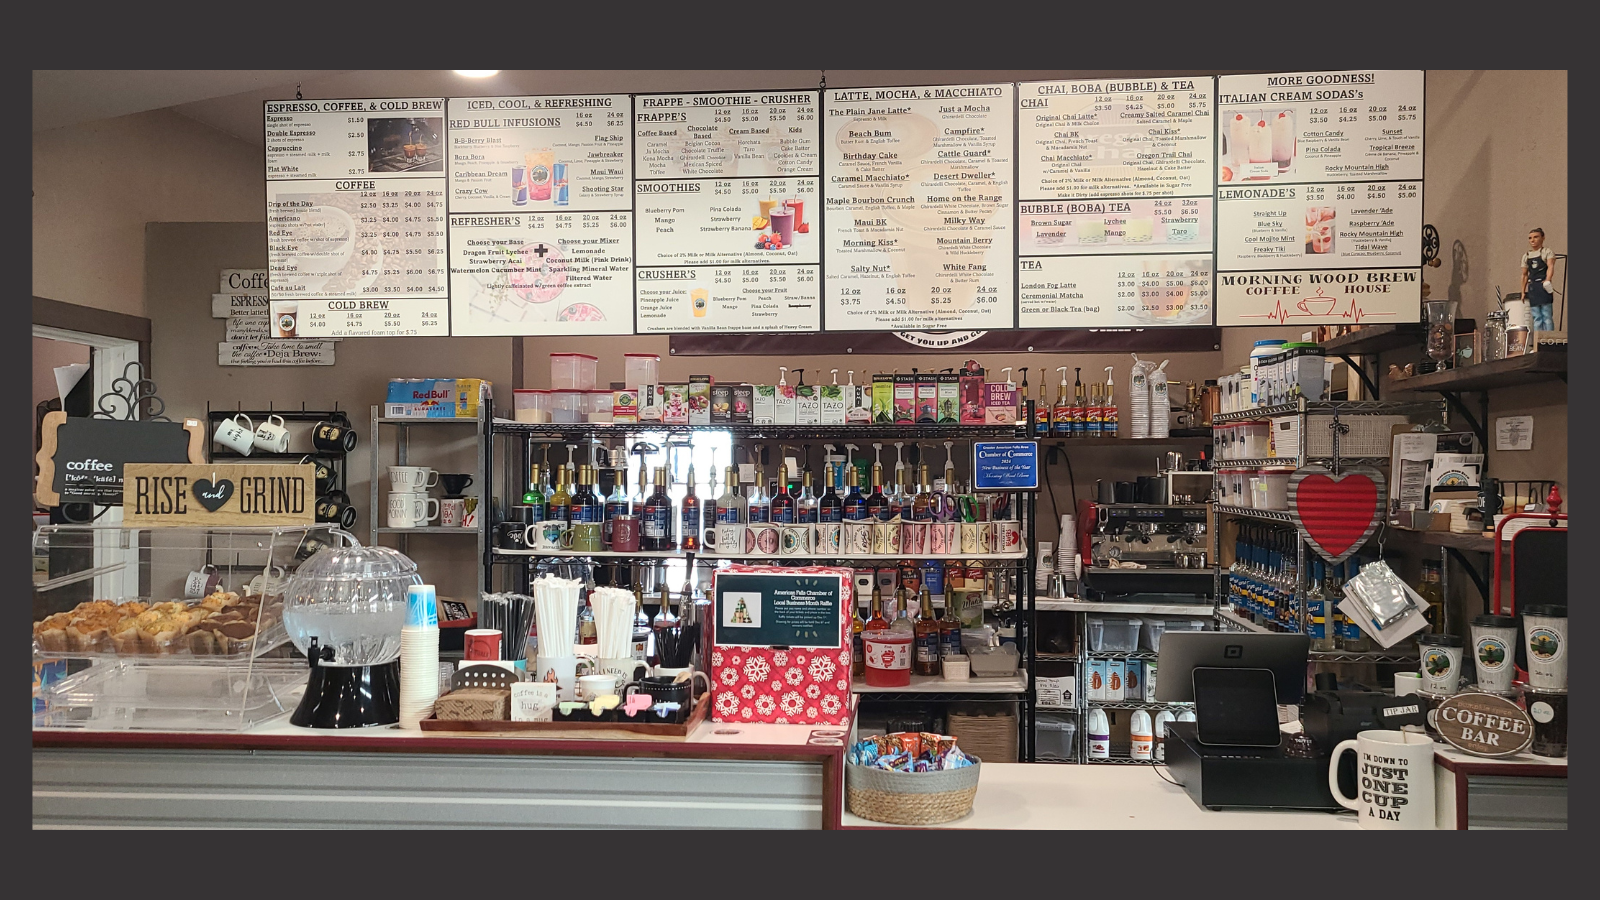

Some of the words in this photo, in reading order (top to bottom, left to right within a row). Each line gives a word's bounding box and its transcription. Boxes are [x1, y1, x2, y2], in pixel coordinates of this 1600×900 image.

[1267, 77, 1302, 86] MORE
[1306, 74, 1374, 84] GOODNESS!
[1038, 86, 1068, 94] CHAI,
[1071, 84, 1102, 93] BOBA
[1105, 82, 1157, 94] (BUBBLE)
[1161, 82, 1169, 90] &
[1172, 81, 1194, 90] TEA
[834, 92, 872, 101] LATTE,
[875, 91, 920, 99] MOCHA,
[934, 88, 1002, 97] MACCHIATO
[1220, 94, 1267, 103] ITALIAN
[1270, 92, 1312, 100] CREAM
[1316, 89, 1363, 99] SODAS's
[467, 101, 495, 110] ICED,
[498, 100, 531, 109] COOL,
[534, 100, 541, 108] &
[545, 98, 612, 107] REFRESHING
[643, 98, 683, 107] FRAPPE
[693, 96, 751, 105] SMOOTHIE
[761, 95, 811, 104] CRUSHER
[1021, 99, 1048, 107] CHAI
[267, 102, 320, 113] ESPRESSO,
[324, 102, 366, 111] COFFEE,
[370, 102, 377, 110] &
[381, 102, 408, 110] COLD
[411, 101, 442, 110] BREW
[637, 113, 687, 121] FRAPPE'S
[450, 120, 470, 128] RED
[473, 119, 500, 127] BULL
[503, 118, 561, 127] INFUSIONS
[335, 181, 375, 189] COFFEE
[637, 183, 701, 192] SMOOTHIES
[1219, 189, 1296, 199] LEMONADE'S
[1021, 204, 1063, 214] BUBBLE
[1067, 203, 1105, 214] (BOBA)
[1109, 203, 1131, 211] TEA
[451, 217, 521, 226] REFRESHER'S
[1021, 261, 1042, 269] TEA
[638, 270, 696, 279] CRUSHER'S
[1221, 274, 1302, 285] MORNING
[1309, 273, 1359, 284] WOOD
[1367, 272, 1417, 282] BREW
[1246, 286, 1300, 295] COFFEE
[1345, 285, 1391, 294] HOUSE
[328, 301, 357, 309] COLD
[359, 301, 389, 309] BREW
[900, 331, 915, 341] GET
[951, 335, 969, 345] AND
[990, 384, 1008, 392] COLD
[413, 390, 430, 399] Red
[431, 390, 448, 398] Bull
[991, 393, 1011, 401] BREW
[979, 450, 1001, 458] Chamber
[1007, 450, 1033, 458] Commerce
[66, 459, 113, 472] coffee
[135, 477, 187, 515] RISE
[202, 485, 226, 500] and
[240, 477, 304, 514] GRIND
[521, 701, 539, 711] hug
[1384, 707, 1399, 716] TIP
[1400, 705, 1418, 714] JAR
[1442, 706, 1526, 735] COFFEE
[1461, 727, 1500, 746] BAR
[1374, 755, 1395, 765] DOWN
[1362, 762, 1408, 780] JUST
[1362, 776, 1408, 795] ONE
[1362, 790, 1408, 808] CUP
[1368, 807, 1375, 817] A
[1379, 809, 1400, 821] DAY
